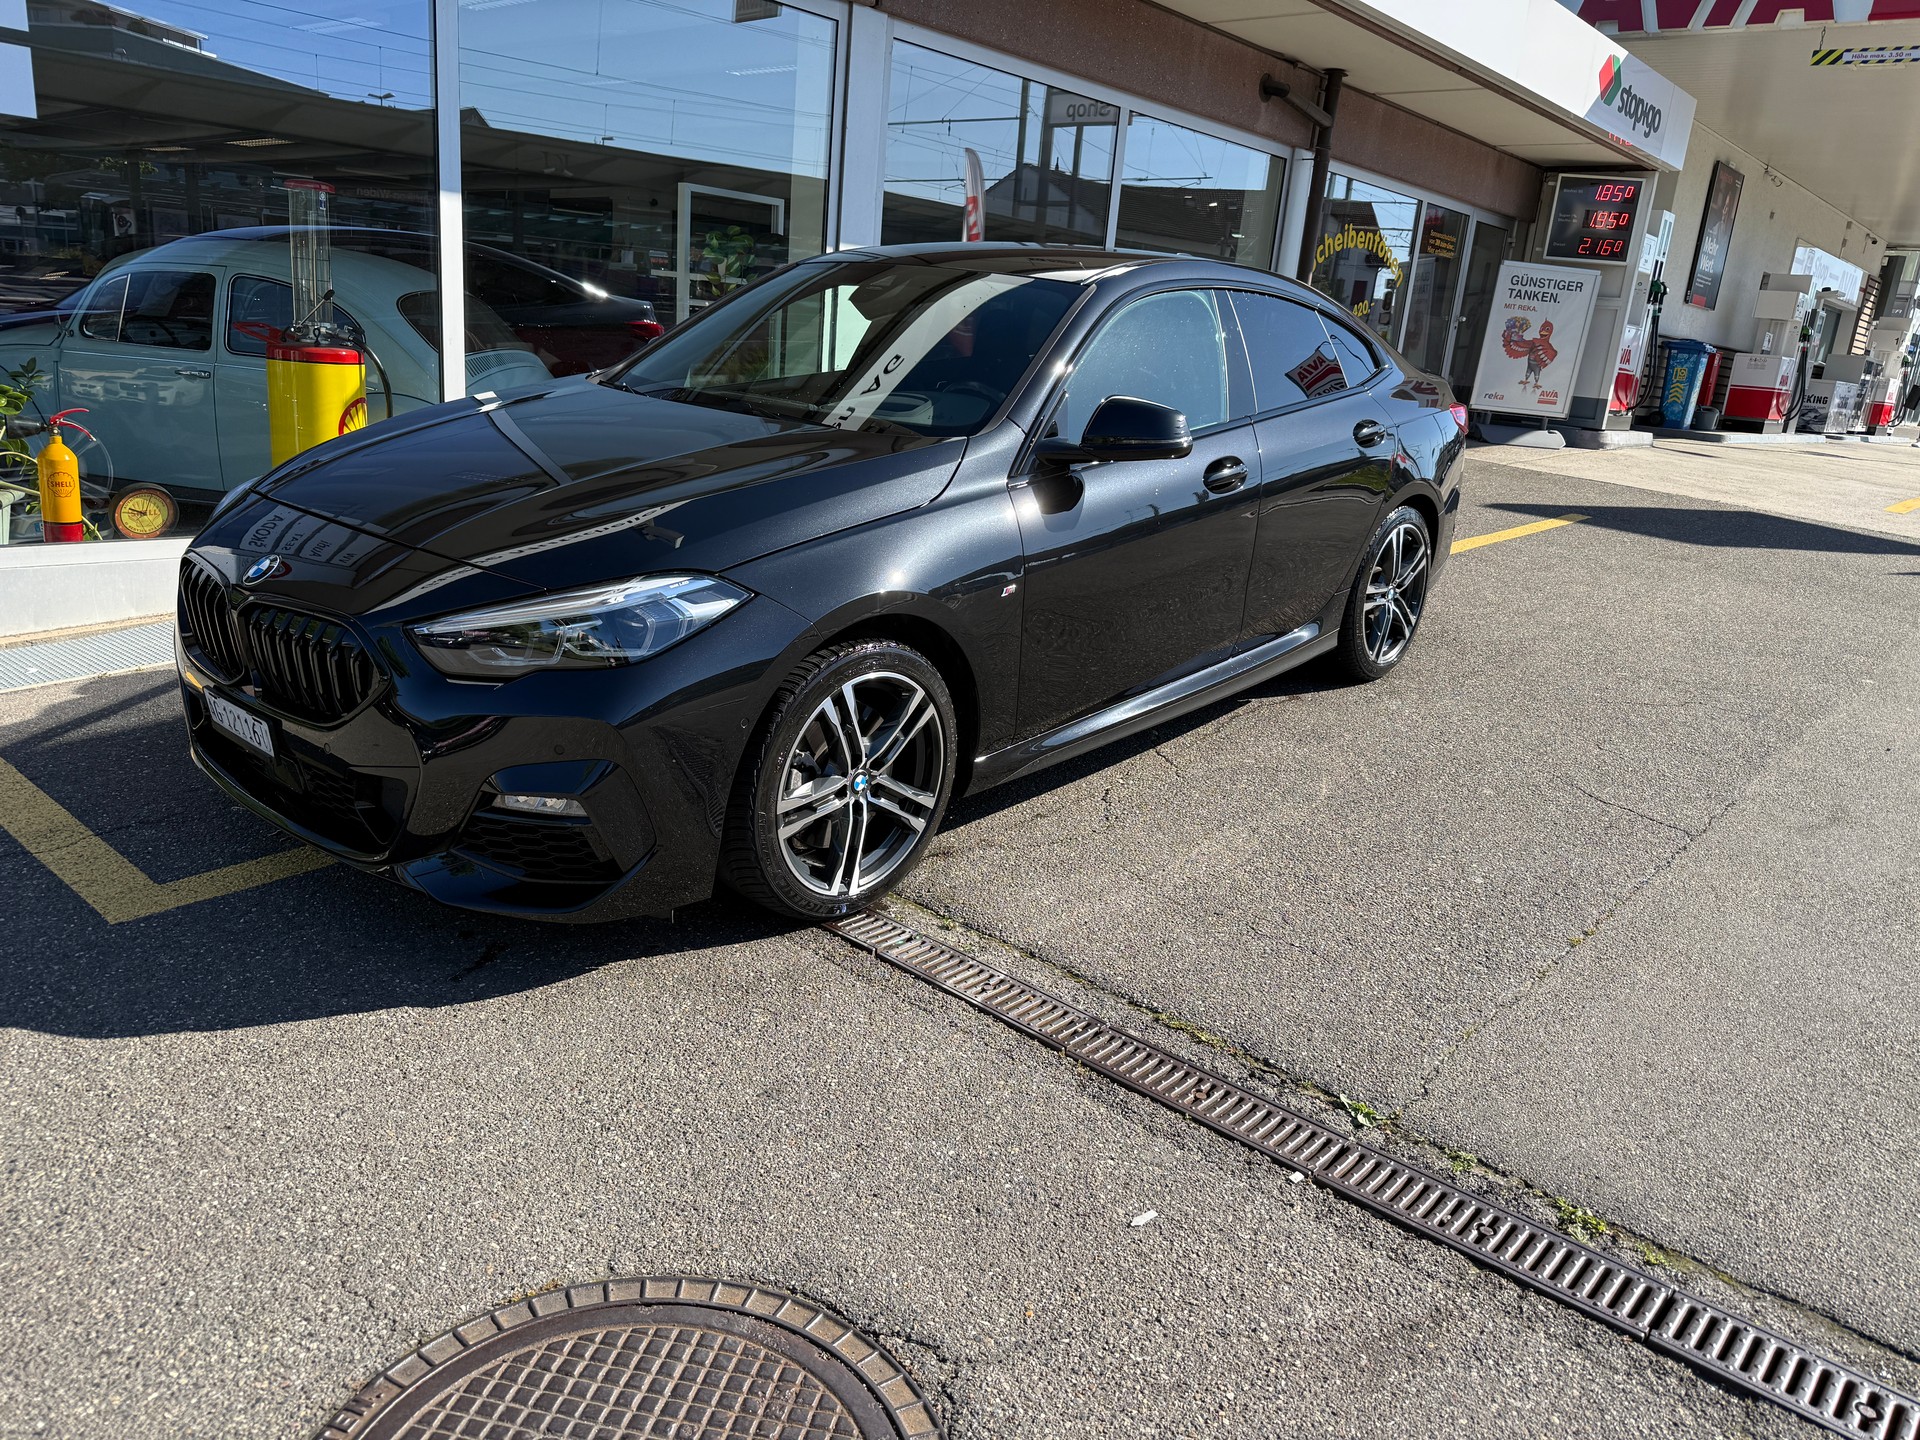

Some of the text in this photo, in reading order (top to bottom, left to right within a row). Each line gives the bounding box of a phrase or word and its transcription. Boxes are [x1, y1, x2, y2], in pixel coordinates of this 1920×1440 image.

[1703, 236, 1719, 256] Mehr
[1311, 223, 1405, 288] cheibentönen
[1510, 273, 1584, 292] GÜNSTIGER
[1508, 288, 1560, 304] TANKEN.
[1503, 302, 1538, 312] MIT REKA.
[1483, 391, 1504, 401] reka
[1539, 389, 1559, 399] AVIA
[1802, 394, 1829, 405] EKING
[50, 480, 73, 488] SHELL
